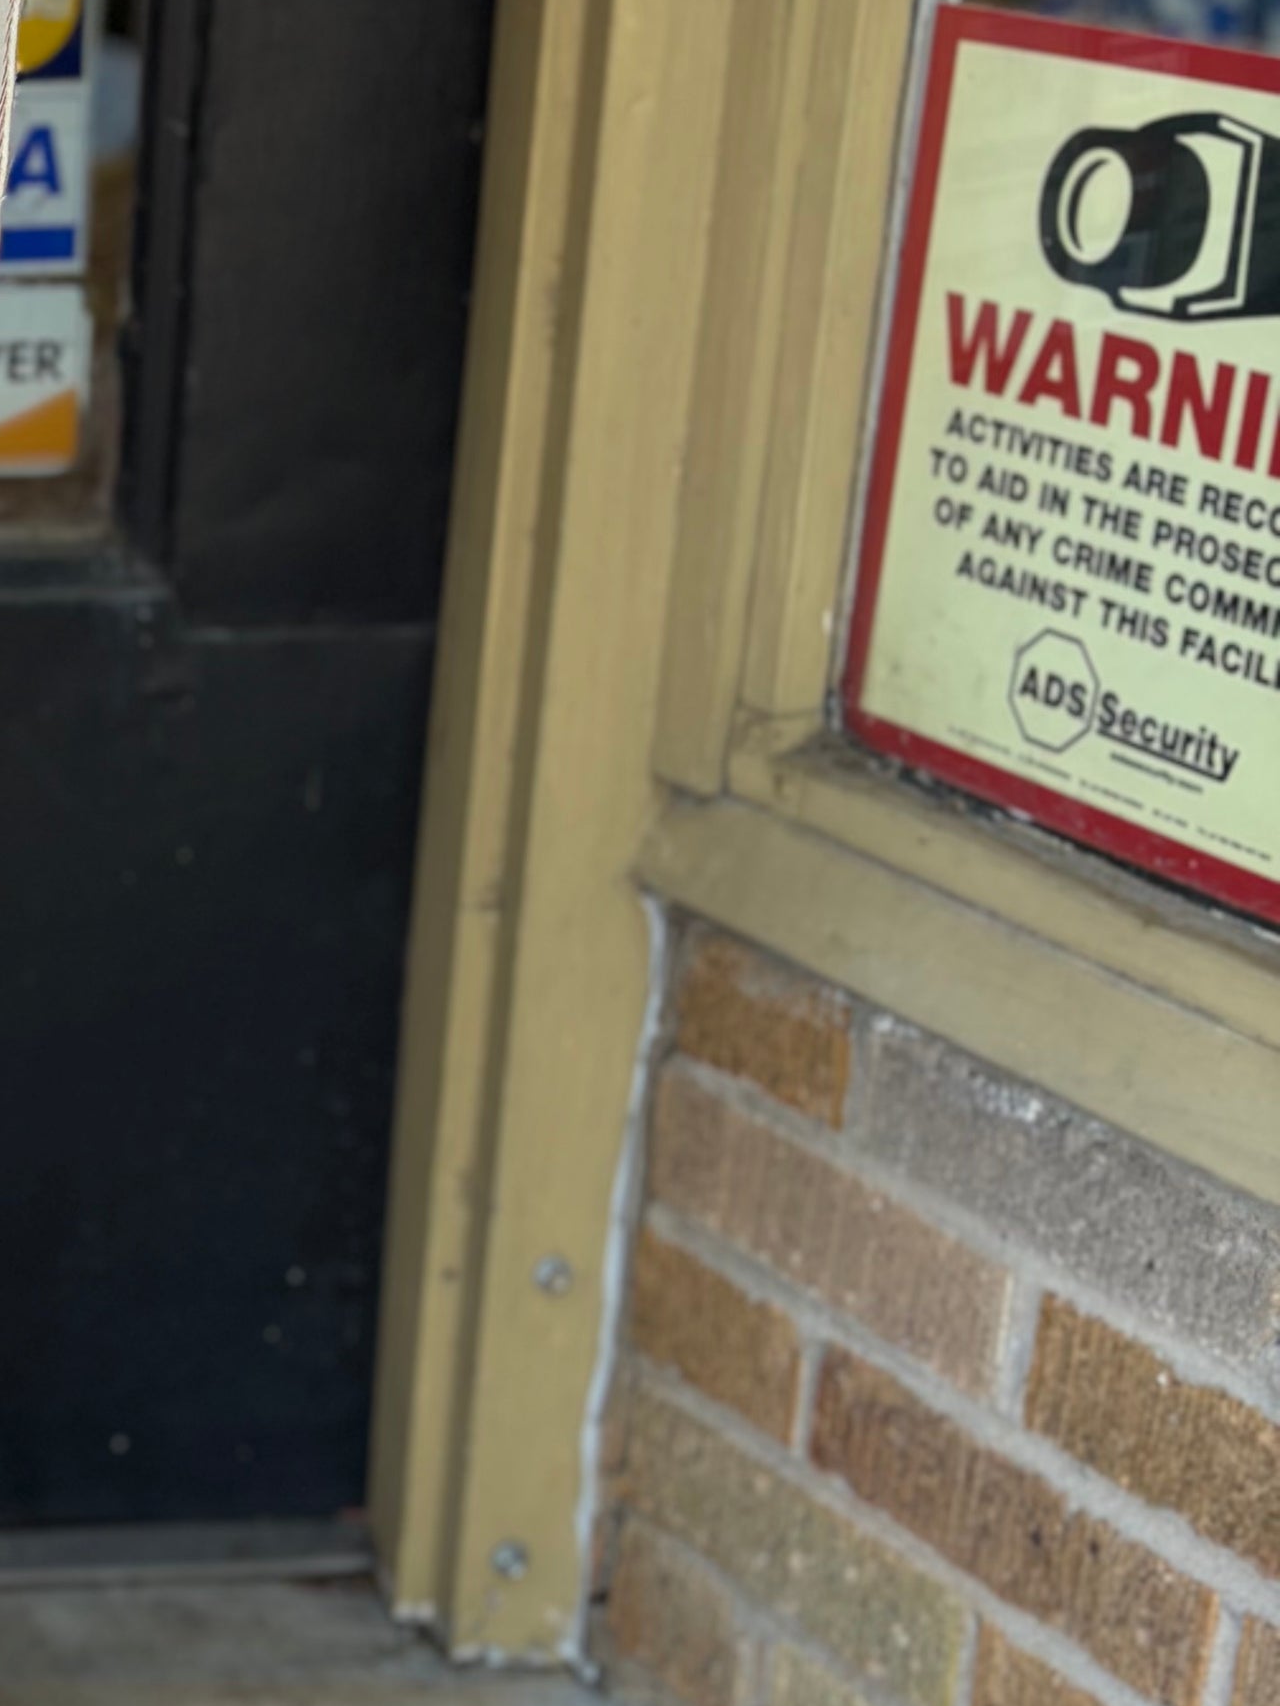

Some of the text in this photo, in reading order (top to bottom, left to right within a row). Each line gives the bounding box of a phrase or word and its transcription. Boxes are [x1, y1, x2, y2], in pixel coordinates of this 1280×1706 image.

[6, 124, 60, 194] A
[930, 448, 968, 484] TO
[977, 464, 1029, 503] AID
[1039, 481, 1071, 517] IN
[1083, 495, 1142, 541] THE
[947, 407, 1114, 483] ACTIVITIES
[1122, 461, 1189, 506] ARE
[933, 496, 973, 532] OF
[982, 511, 1045, 555] ANY
[1052, 535, 1154, 594] CRIME
[956, 550, 1089, 619] AGAINST
[1100, 597, 1170, 649] THIS
[1019, 666, 1087, 719] ADS
[1097, 691, 1240, 777] Security
